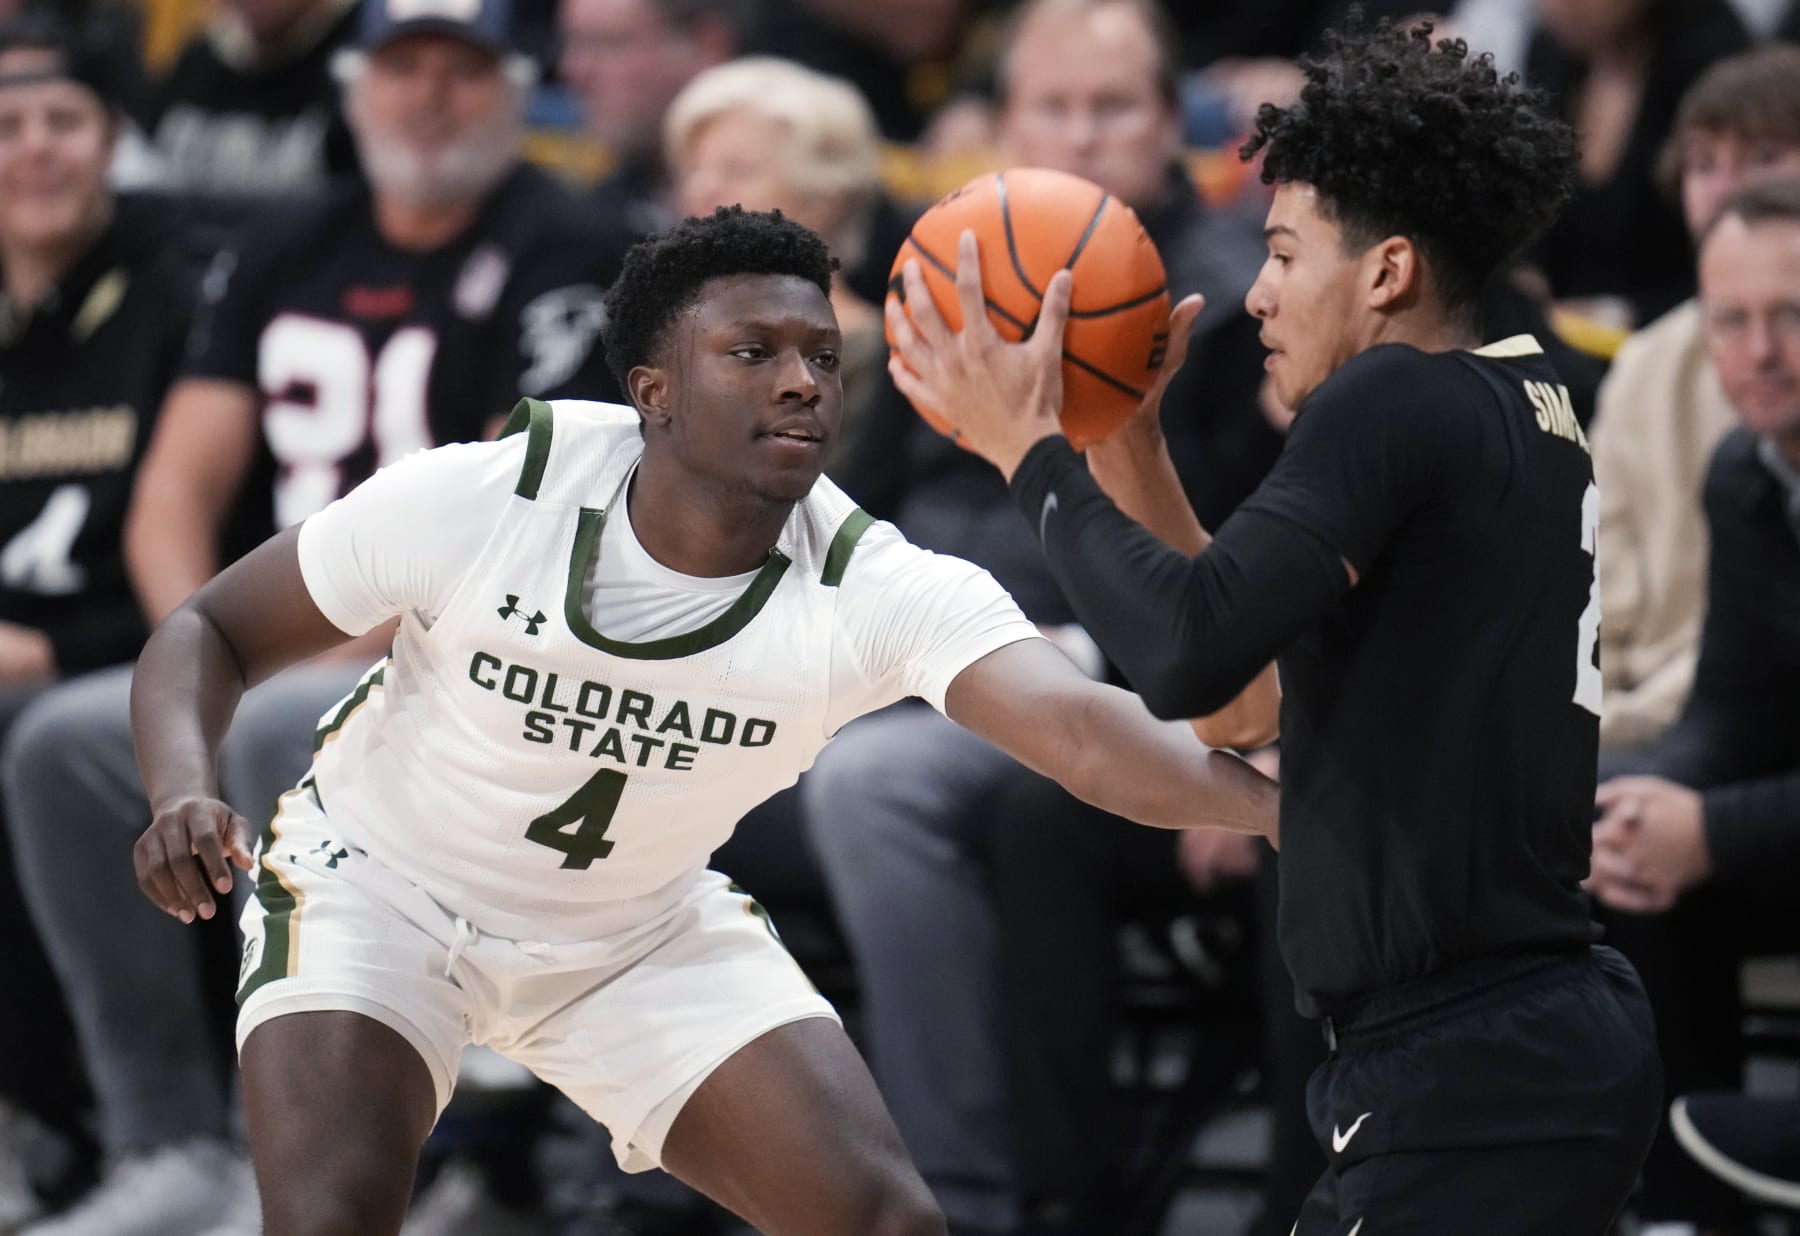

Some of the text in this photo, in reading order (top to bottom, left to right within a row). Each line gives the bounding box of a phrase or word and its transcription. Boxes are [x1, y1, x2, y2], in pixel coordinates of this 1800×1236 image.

[258, 313, 437, 530] 21
[469, 651, 777, 747] COLORADO
[523, 711, 700, 771] STATE
[524, 768, 628, 870] 4
